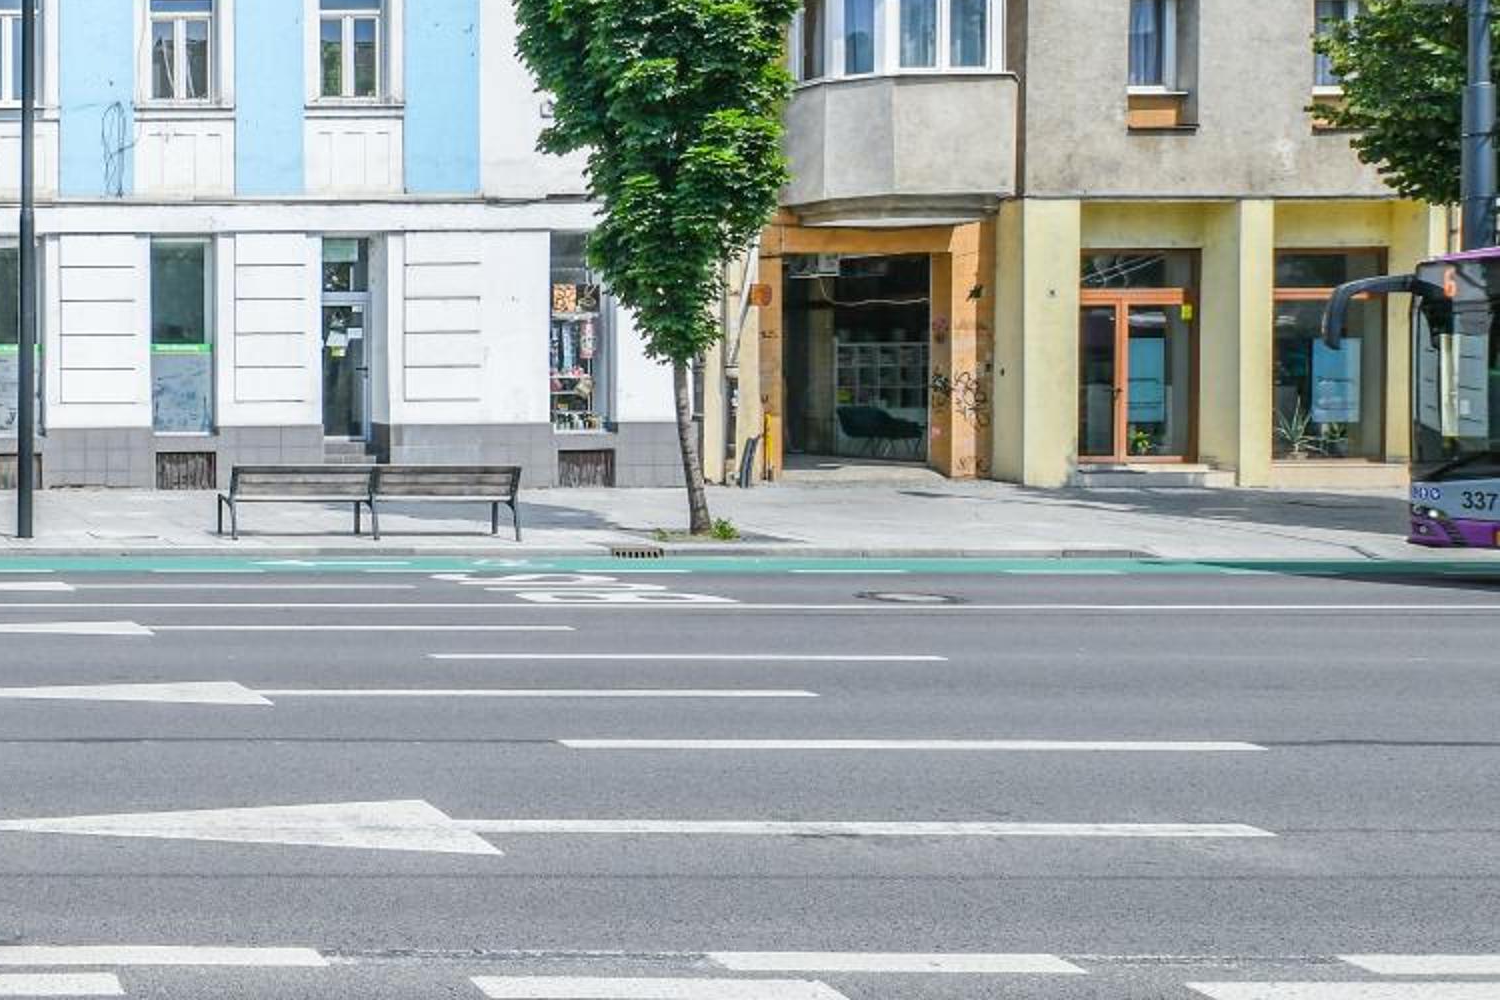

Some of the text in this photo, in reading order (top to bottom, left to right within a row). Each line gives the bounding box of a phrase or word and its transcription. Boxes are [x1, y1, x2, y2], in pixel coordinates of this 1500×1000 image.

[1443, 265, 1457, 298] 6
[1462, 490, 1499, 511] 337
[428, 573, 741, 603] BUS
